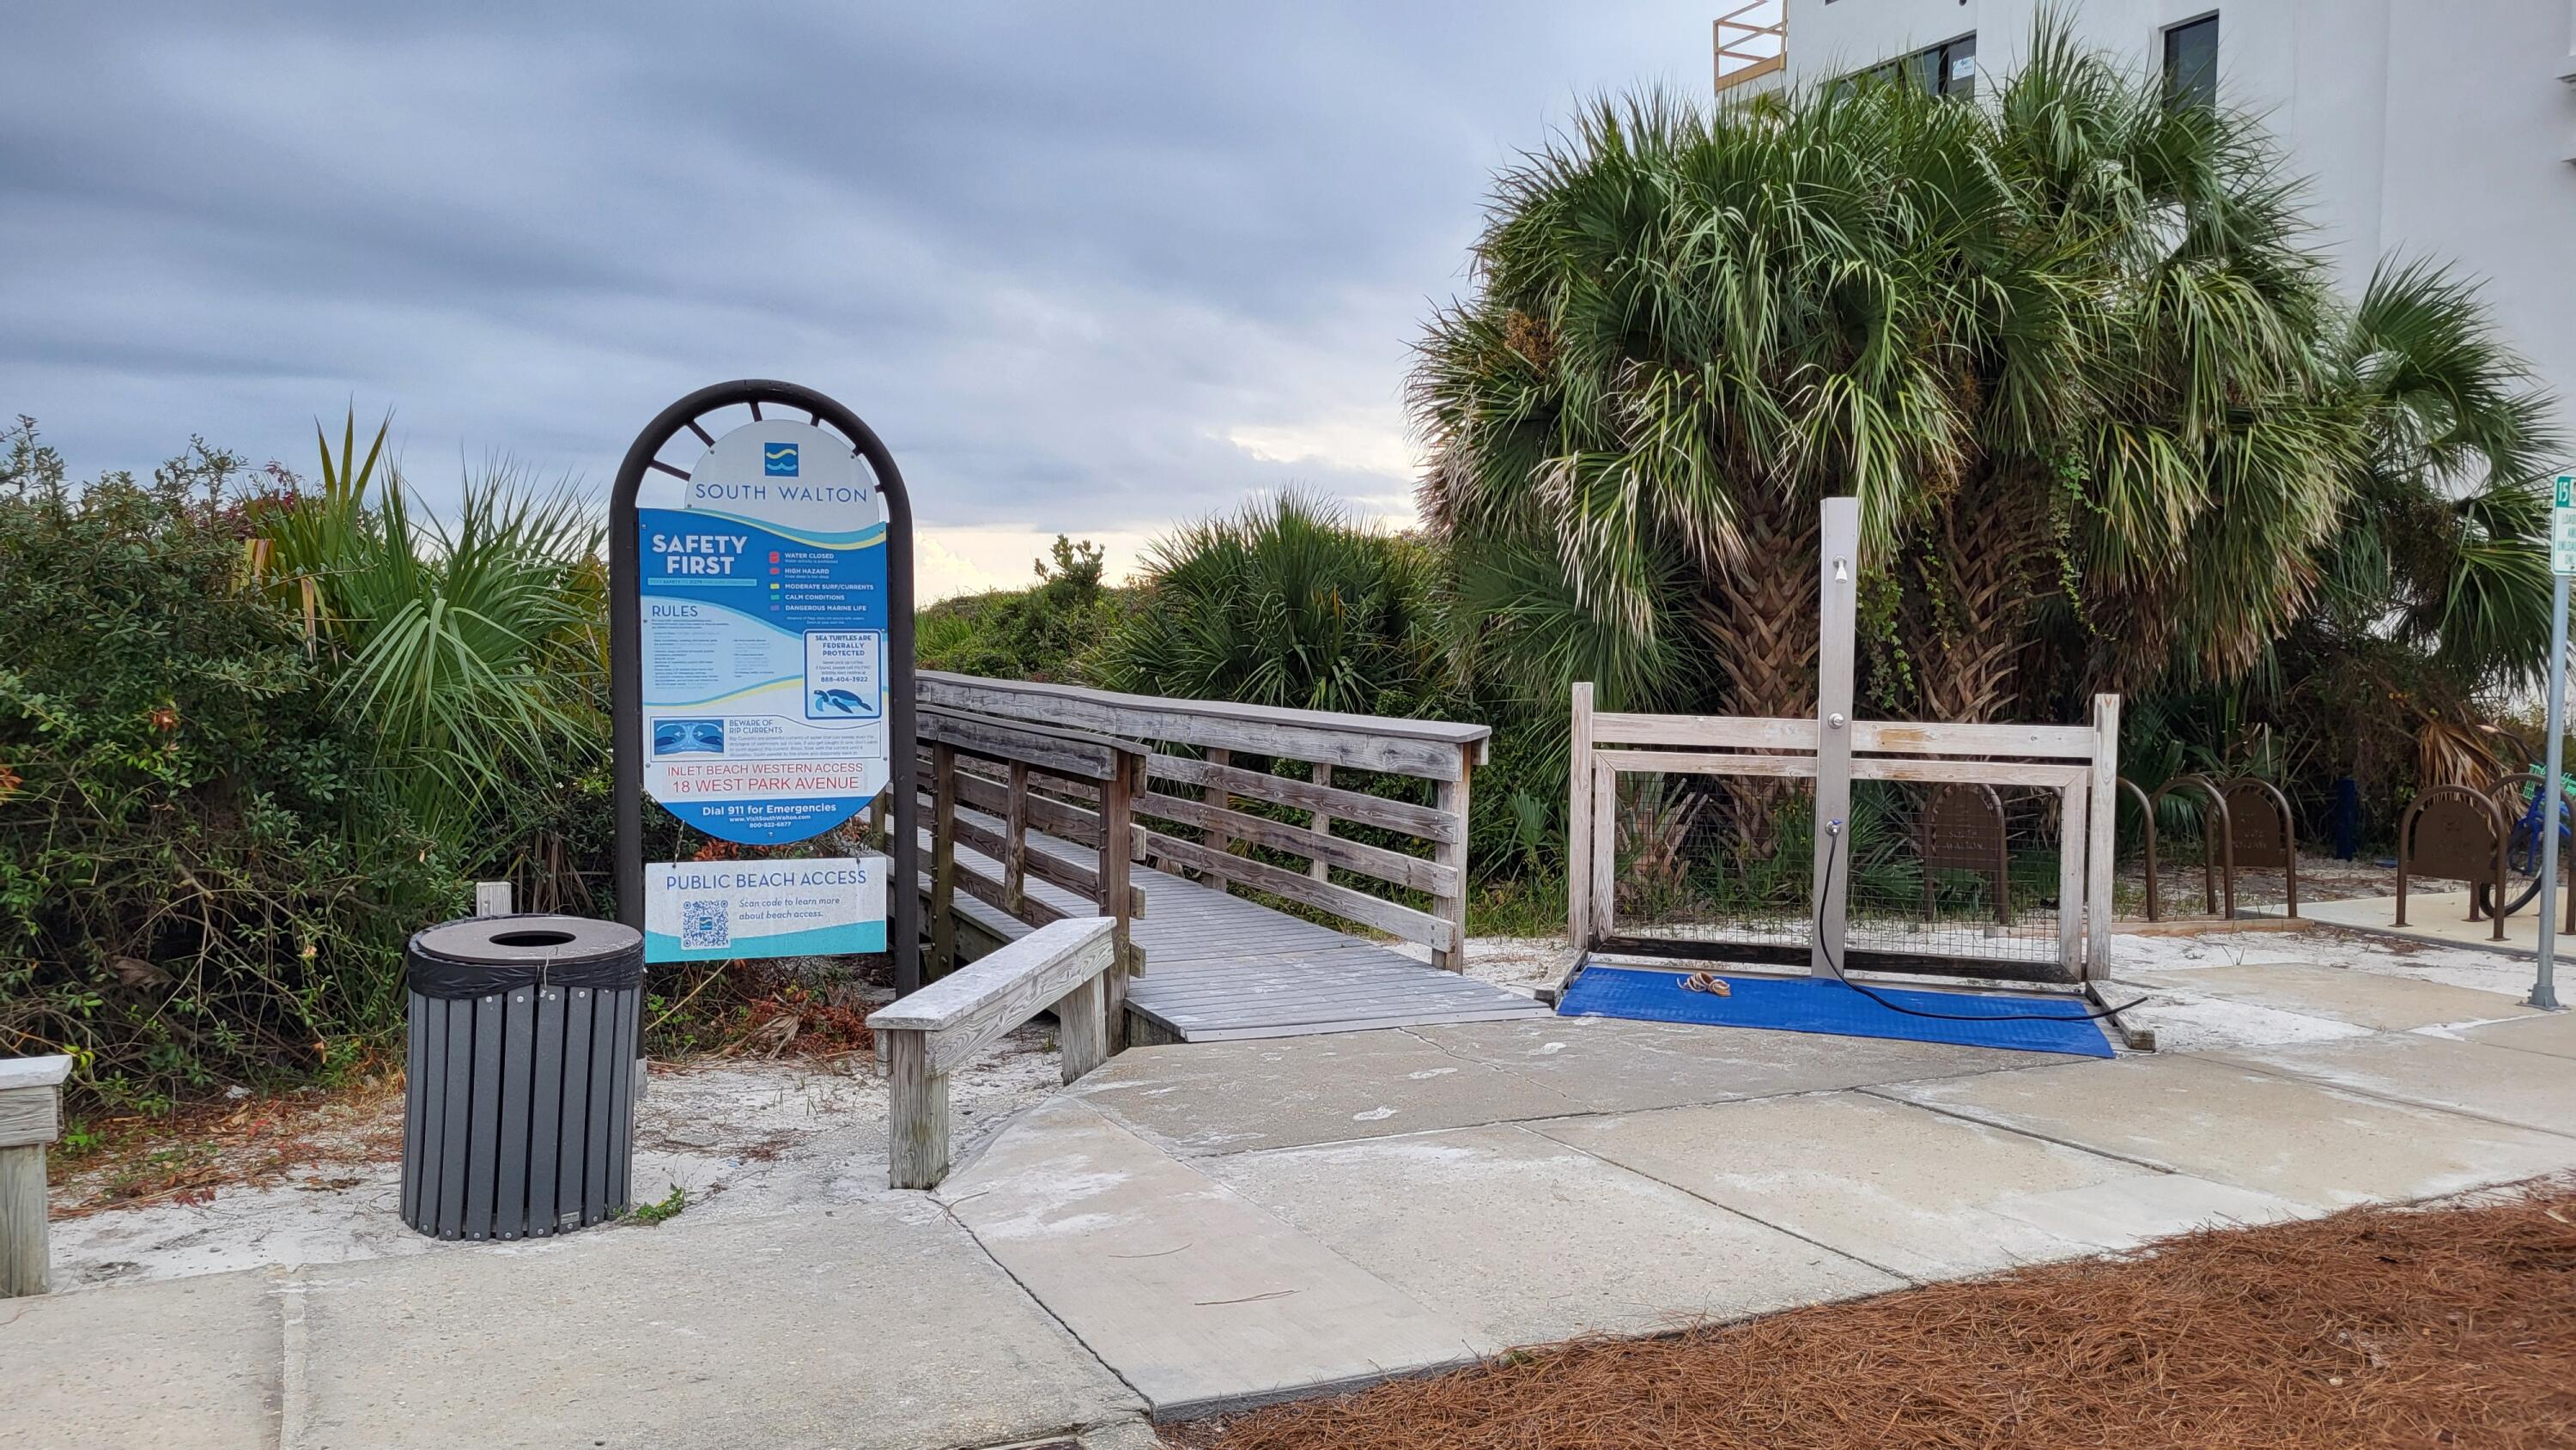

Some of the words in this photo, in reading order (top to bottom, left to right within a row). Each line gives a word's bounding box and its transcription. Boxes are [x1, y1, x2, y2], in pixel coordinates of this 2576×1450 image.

[696, 483, 766, 501] SOUTH
[779, 486, 867, 502] WALTON
[652, 535, 748, 555] SAFETY
[667, 555, 734, 574] FIRST
[653, 605, 698, 617] RULES
[667, 766, 702, 777] INLET
[707, 764, 749, 776] BEACH
[750, 763, 813, 774] WESTERN
[815, 762, 863, 774] ACCESS
[672, 780, 690, 793] 18
[696, 779, 743, 792] WEST
[748, 777, 791, 791] PARK
[794, 776, 860, 790] AVENUE
[702, 805, 725, 816] Dial
[728, 805, 744, 815] 911
[747, 804, 763, 814] for
[767, 803, 836, 815] Emergencies
[666, 874, 731, 890] PUBLIC
[736, 872, 795, 889] BEACH
[800, 870, 866, 886] ACCESS
[739, 899, 760, 908] Scan
[762, 897, 782, 907] code
[785, 898, 794, 907] to
[795, 896, 817, 906] learn
[818, 897, 841, 906] more
[738, 910, 764, 920] about
[766, 909, 793, 919] beach
[793, 910, 824, 919] access.
